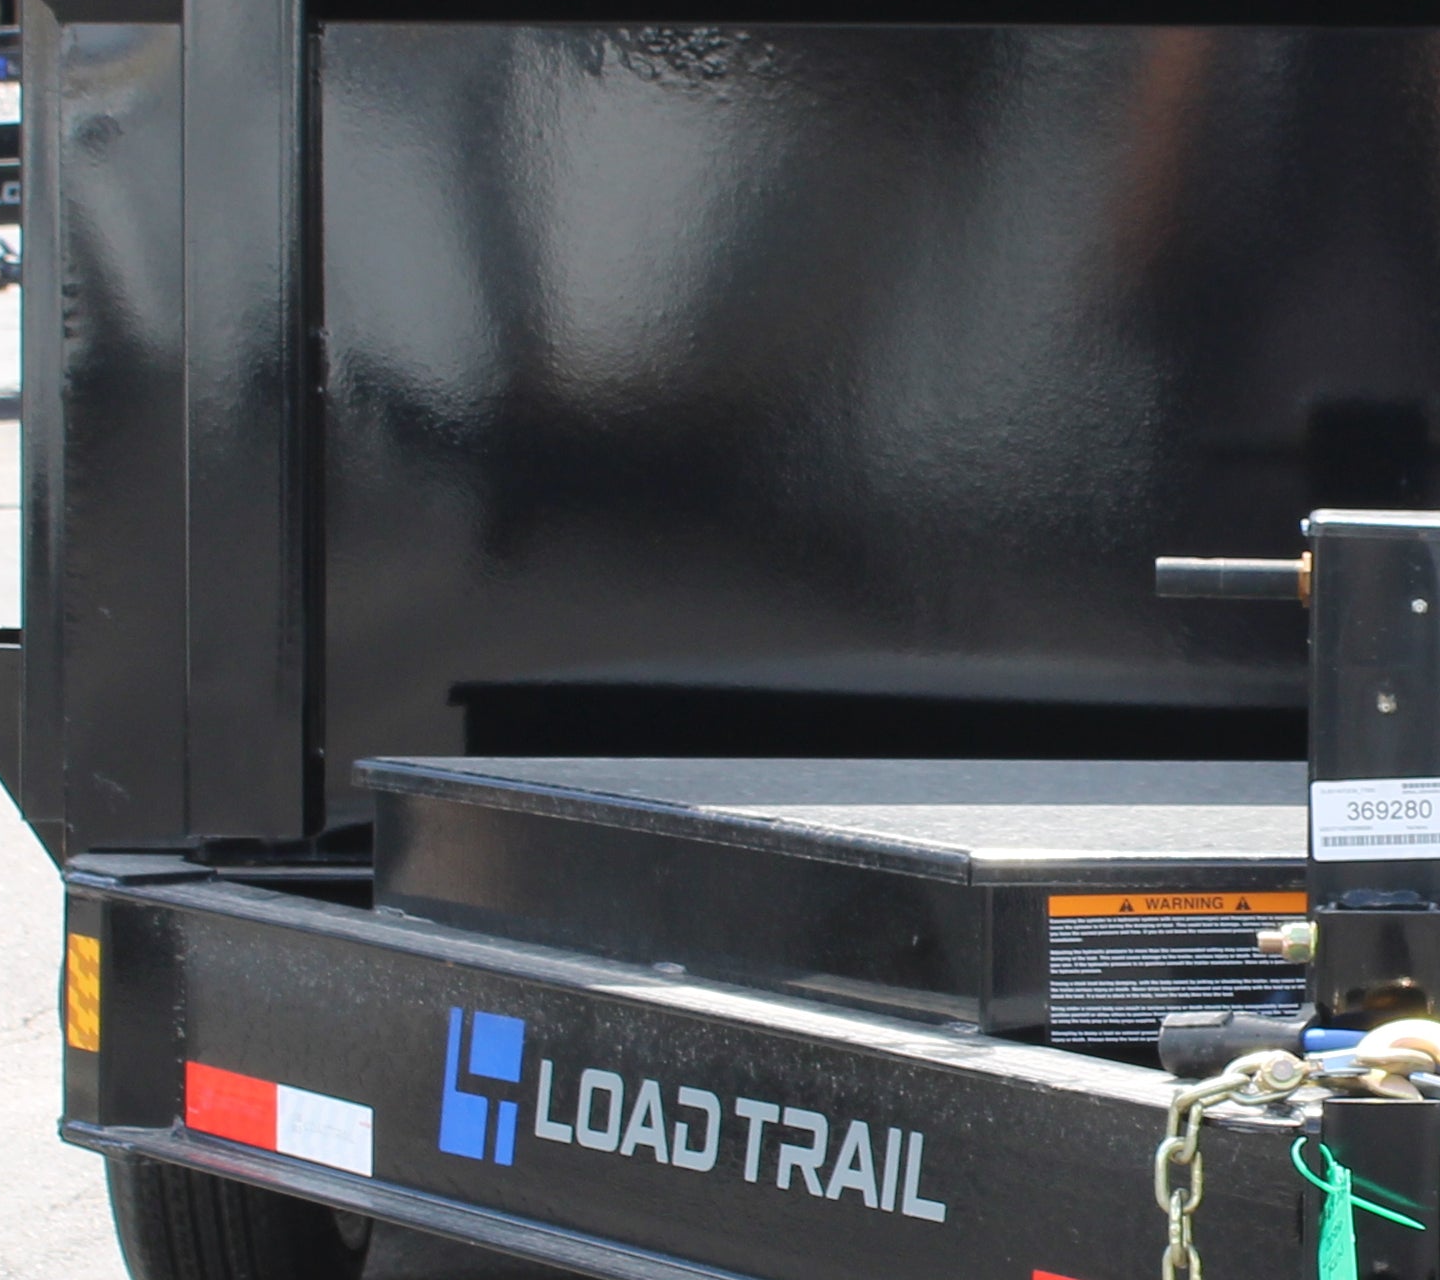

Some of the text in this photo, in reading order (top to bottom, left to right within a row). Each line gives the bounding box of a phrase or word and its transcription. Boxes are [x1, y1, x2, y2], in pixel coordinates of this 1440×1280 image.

[1347, 799, 1433, 821] 369280
[1145, 897, 1224, 910] WARNING
[533, 1059, 947, 1223] LOAD TRAIL
